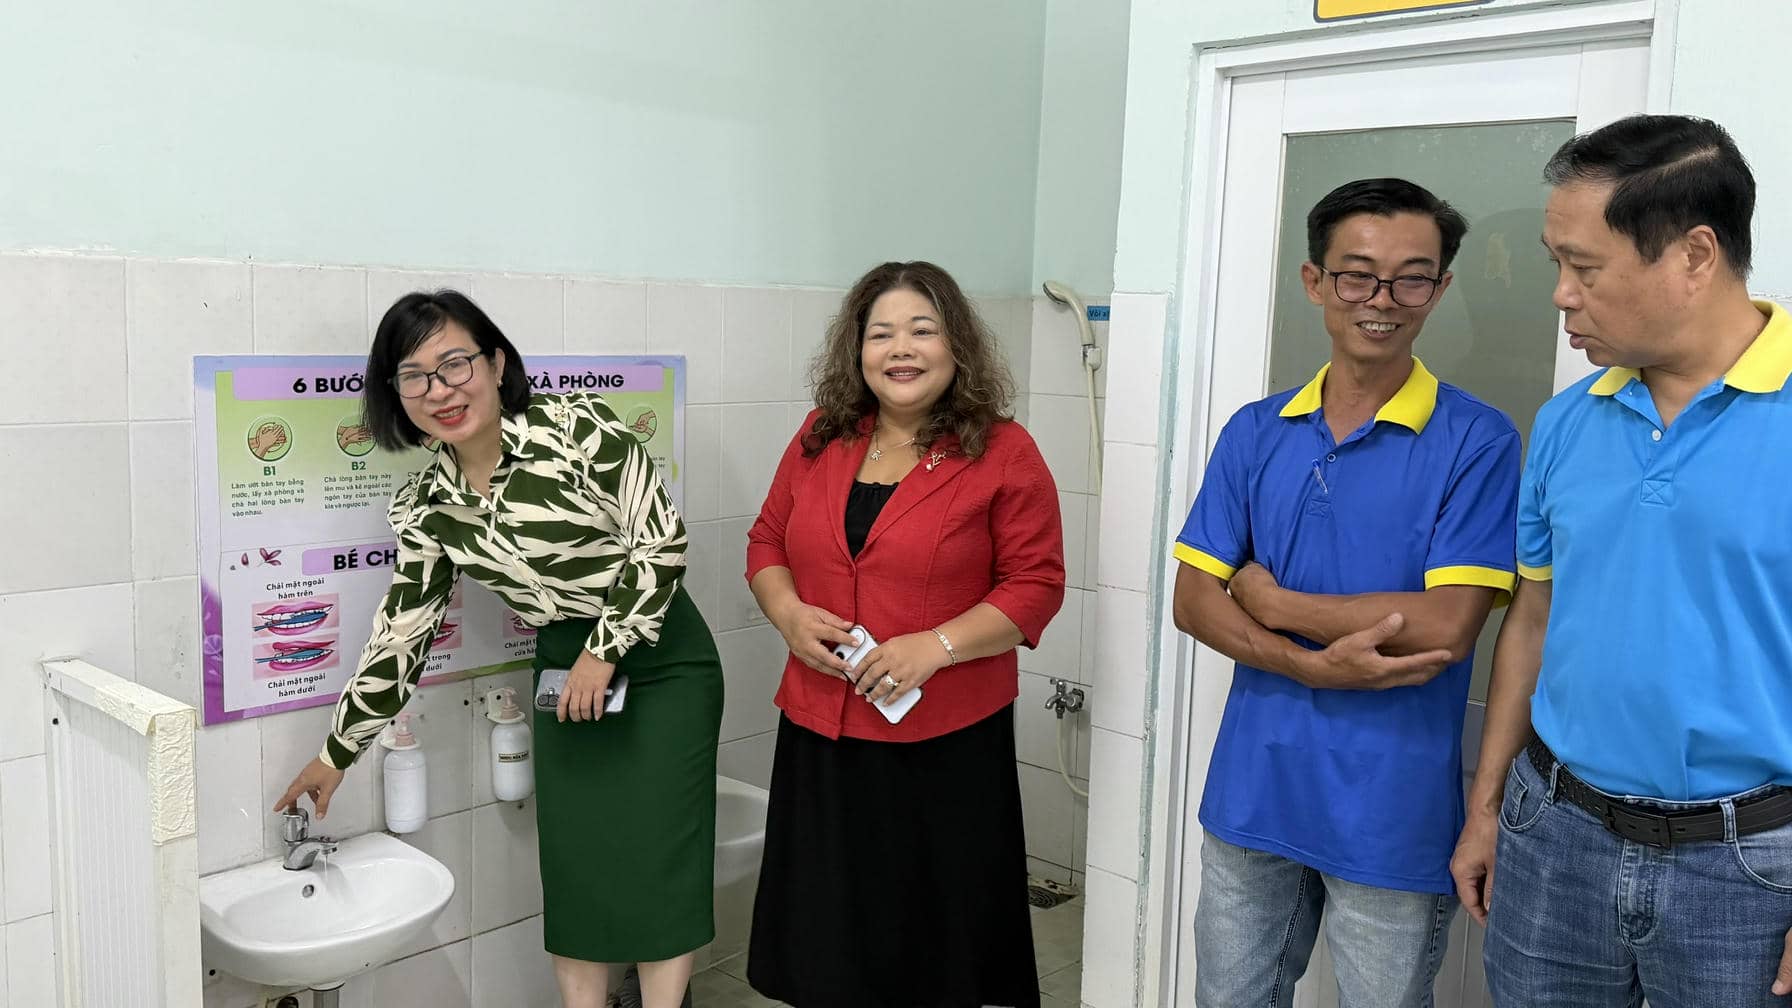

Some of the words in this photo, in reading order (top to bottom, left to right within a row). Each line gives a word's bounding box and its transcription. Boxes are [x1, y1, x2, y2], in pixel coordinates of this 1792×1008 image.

[292, 377, 307, 393] 6
[315, 373, 364, 393] BƯỚ
[527, 371, 553, 389] XÀ
[559, 371, 625, 389] PHÒNG
[263, 466, 276, 476] B1
[351, 461, 366, 471] B2
[333, 548, 358, 570] BÉ
[266, 582, 284, 590] Chải
[285, 580, 301, 588] mặt
[302, 577, 325, 587] ngoài
[278, 592, 295, 600] hàm
[297, 589, 313, 597] trên
[432, 653, 451, 661] trong
[267, 679, 285, 688] Chải
[286, 677, 302, 686] mặt
[303, 673, 326, 684] ngoài
[278, 689, 296, 697] hàm
[297, 685, 316, 694] dưới
